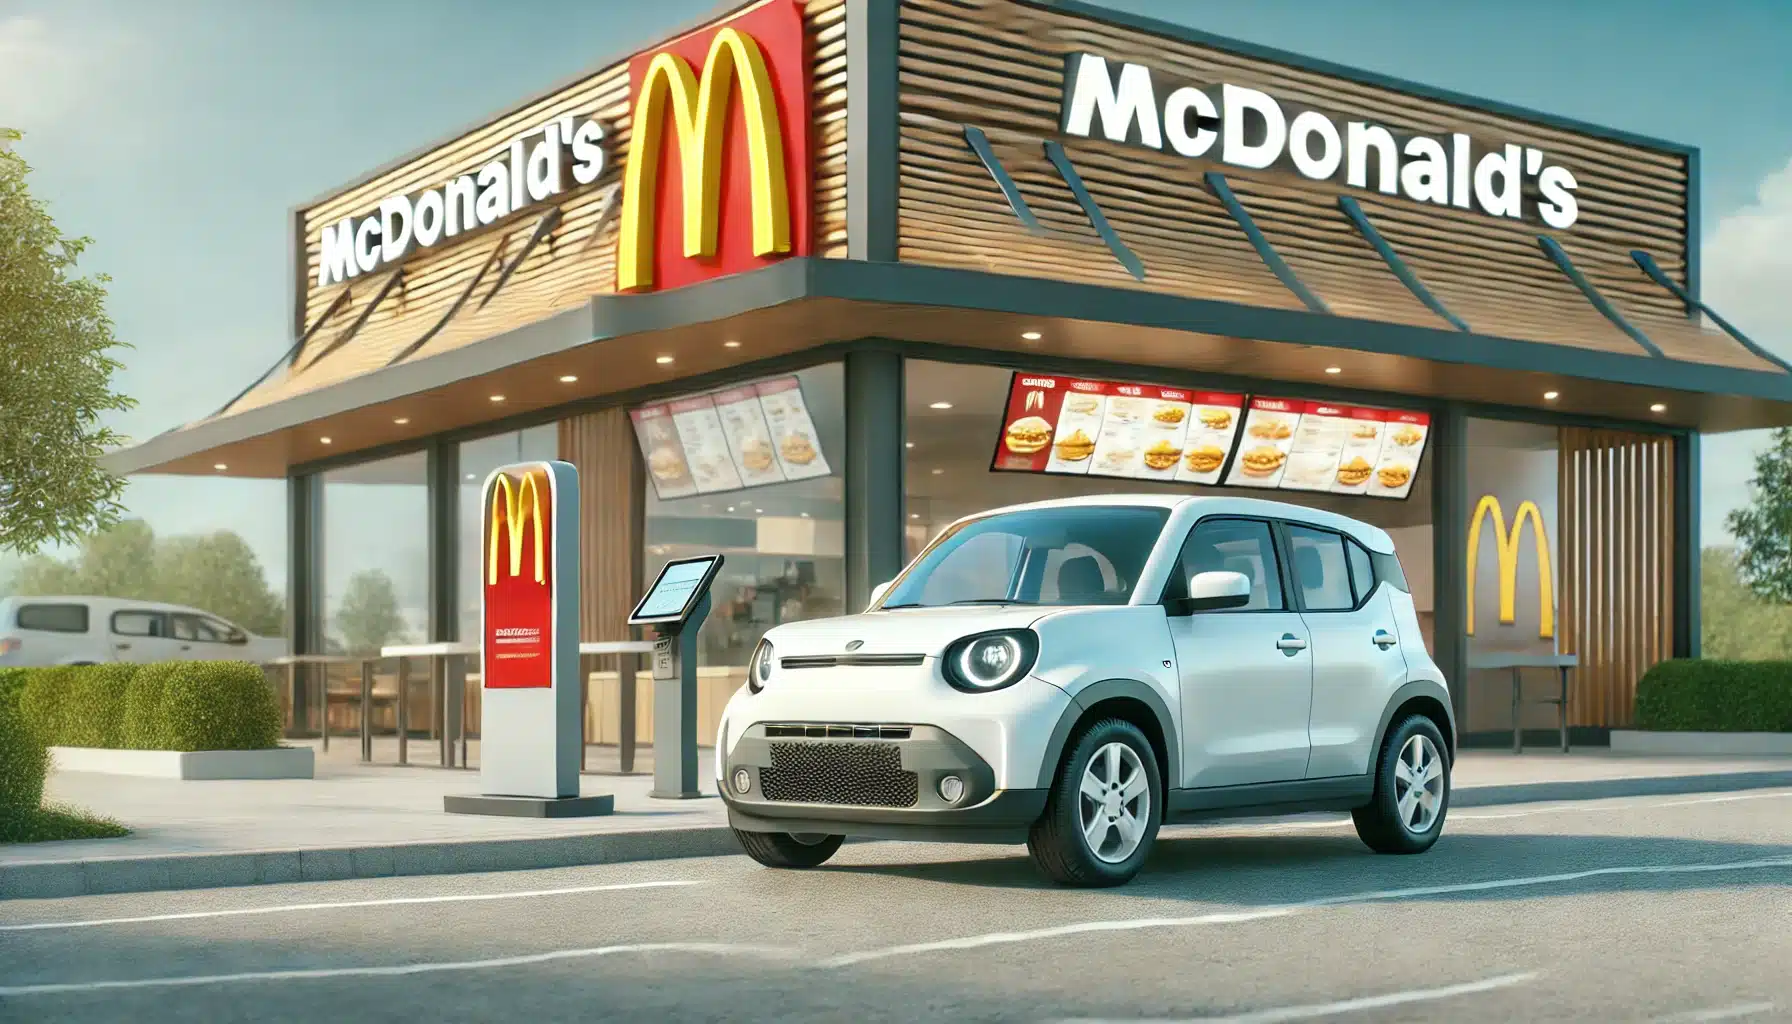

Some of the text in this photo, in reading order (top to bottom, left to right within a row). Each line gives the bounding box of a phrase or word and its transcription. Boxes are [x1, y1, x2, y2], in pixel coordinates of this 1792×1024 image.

[317, 116, 605, 286] McDonald's
[617, 27, 791, 292] M
[1065, 53, 1579, 229] McDonald's
[489, 472, 545, 586] M
[1466, 495, 1554, 639] M
